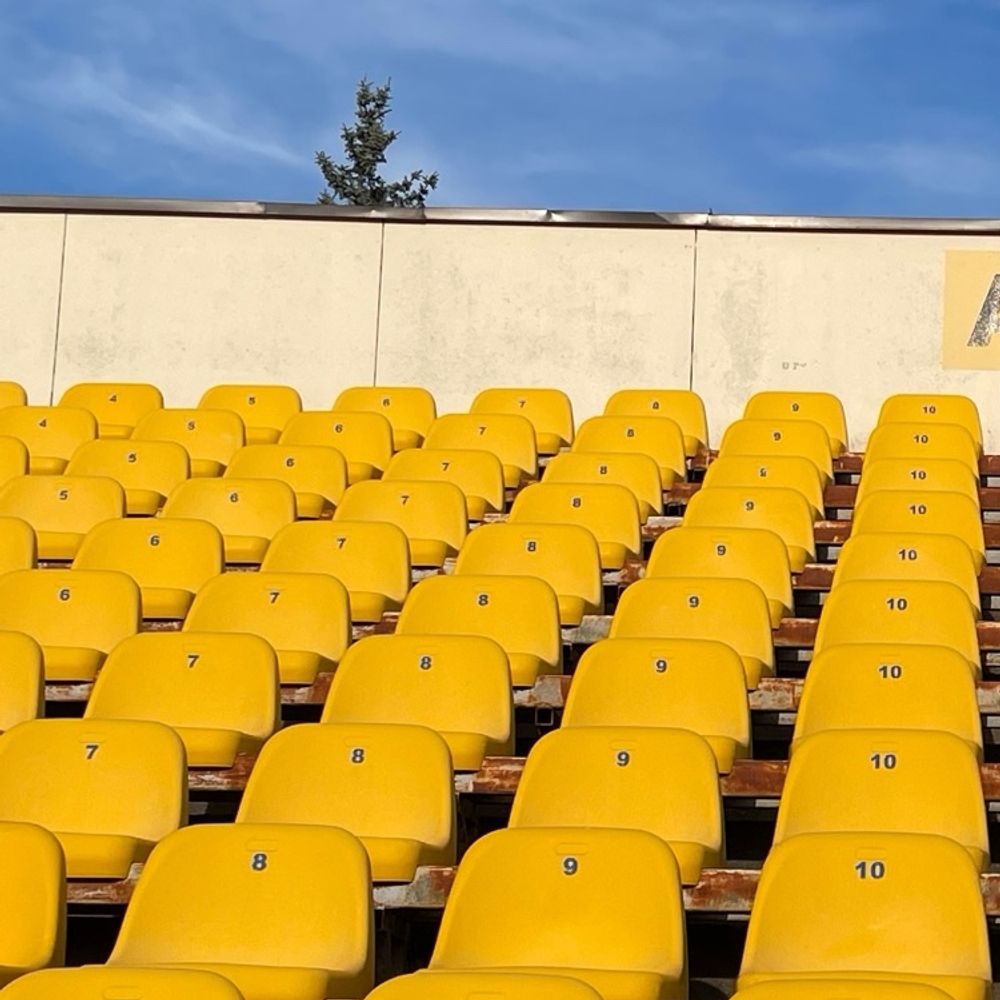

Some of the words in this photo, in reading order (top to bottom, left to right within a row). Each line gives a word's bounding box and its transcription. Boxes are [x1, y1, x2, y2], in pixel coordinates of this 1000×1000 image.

[519, 400, 526, 408] 7
[922, 405, 937, 415] 10
[38, 418, 47, 428] 4
[334, 423, 344, 434] 6
[479, 426, 487, 436] 7
[773, 431, 782, 442] 9
[913, 434, 929, 444] 10
[128, 452, 137, 464] 5
[285, 457, 295, 468] 6
[441, 461, 450, 472] 7
[910, 470, 927, 481] 10
[59, 489, 69, 501] 5
[229, 492, 239, 503] 6
[400, 494, 410, 505] 7
[572, 497, 582, 509] 8
[744, 500, 755, 512] 9
[909, 503, 927, 516] 10
[149, 534, 161, 547] 6
[336, 537, 347, 550] 7
[526, 540, 537, 553] 8
[716, 544, 727, 557] 9
[898, 548, 918, 561] 10
[58, 588, 71, 602] 6
[269, 591, 281, 604] 7
[477, 593, 489, 607] 8
[688, 595, 700, 609] 9
[886, 597, 908, 611] 10
[187, 654, 200, 669] 7
[420, 656, 432, 670] 8
[655, 659, 668, 674] 9
[879, 665, 902, 679] 10
[86, 744, 99, 760] 7
[351, 748, 364, 763] 8
[617, 751, 630, 767] 9
[871, 754, 896, 769] 10
[251, 853, 267, 871] 8
[563, 857, 578, 876] 9
[855, 861, 885, 879] 10
